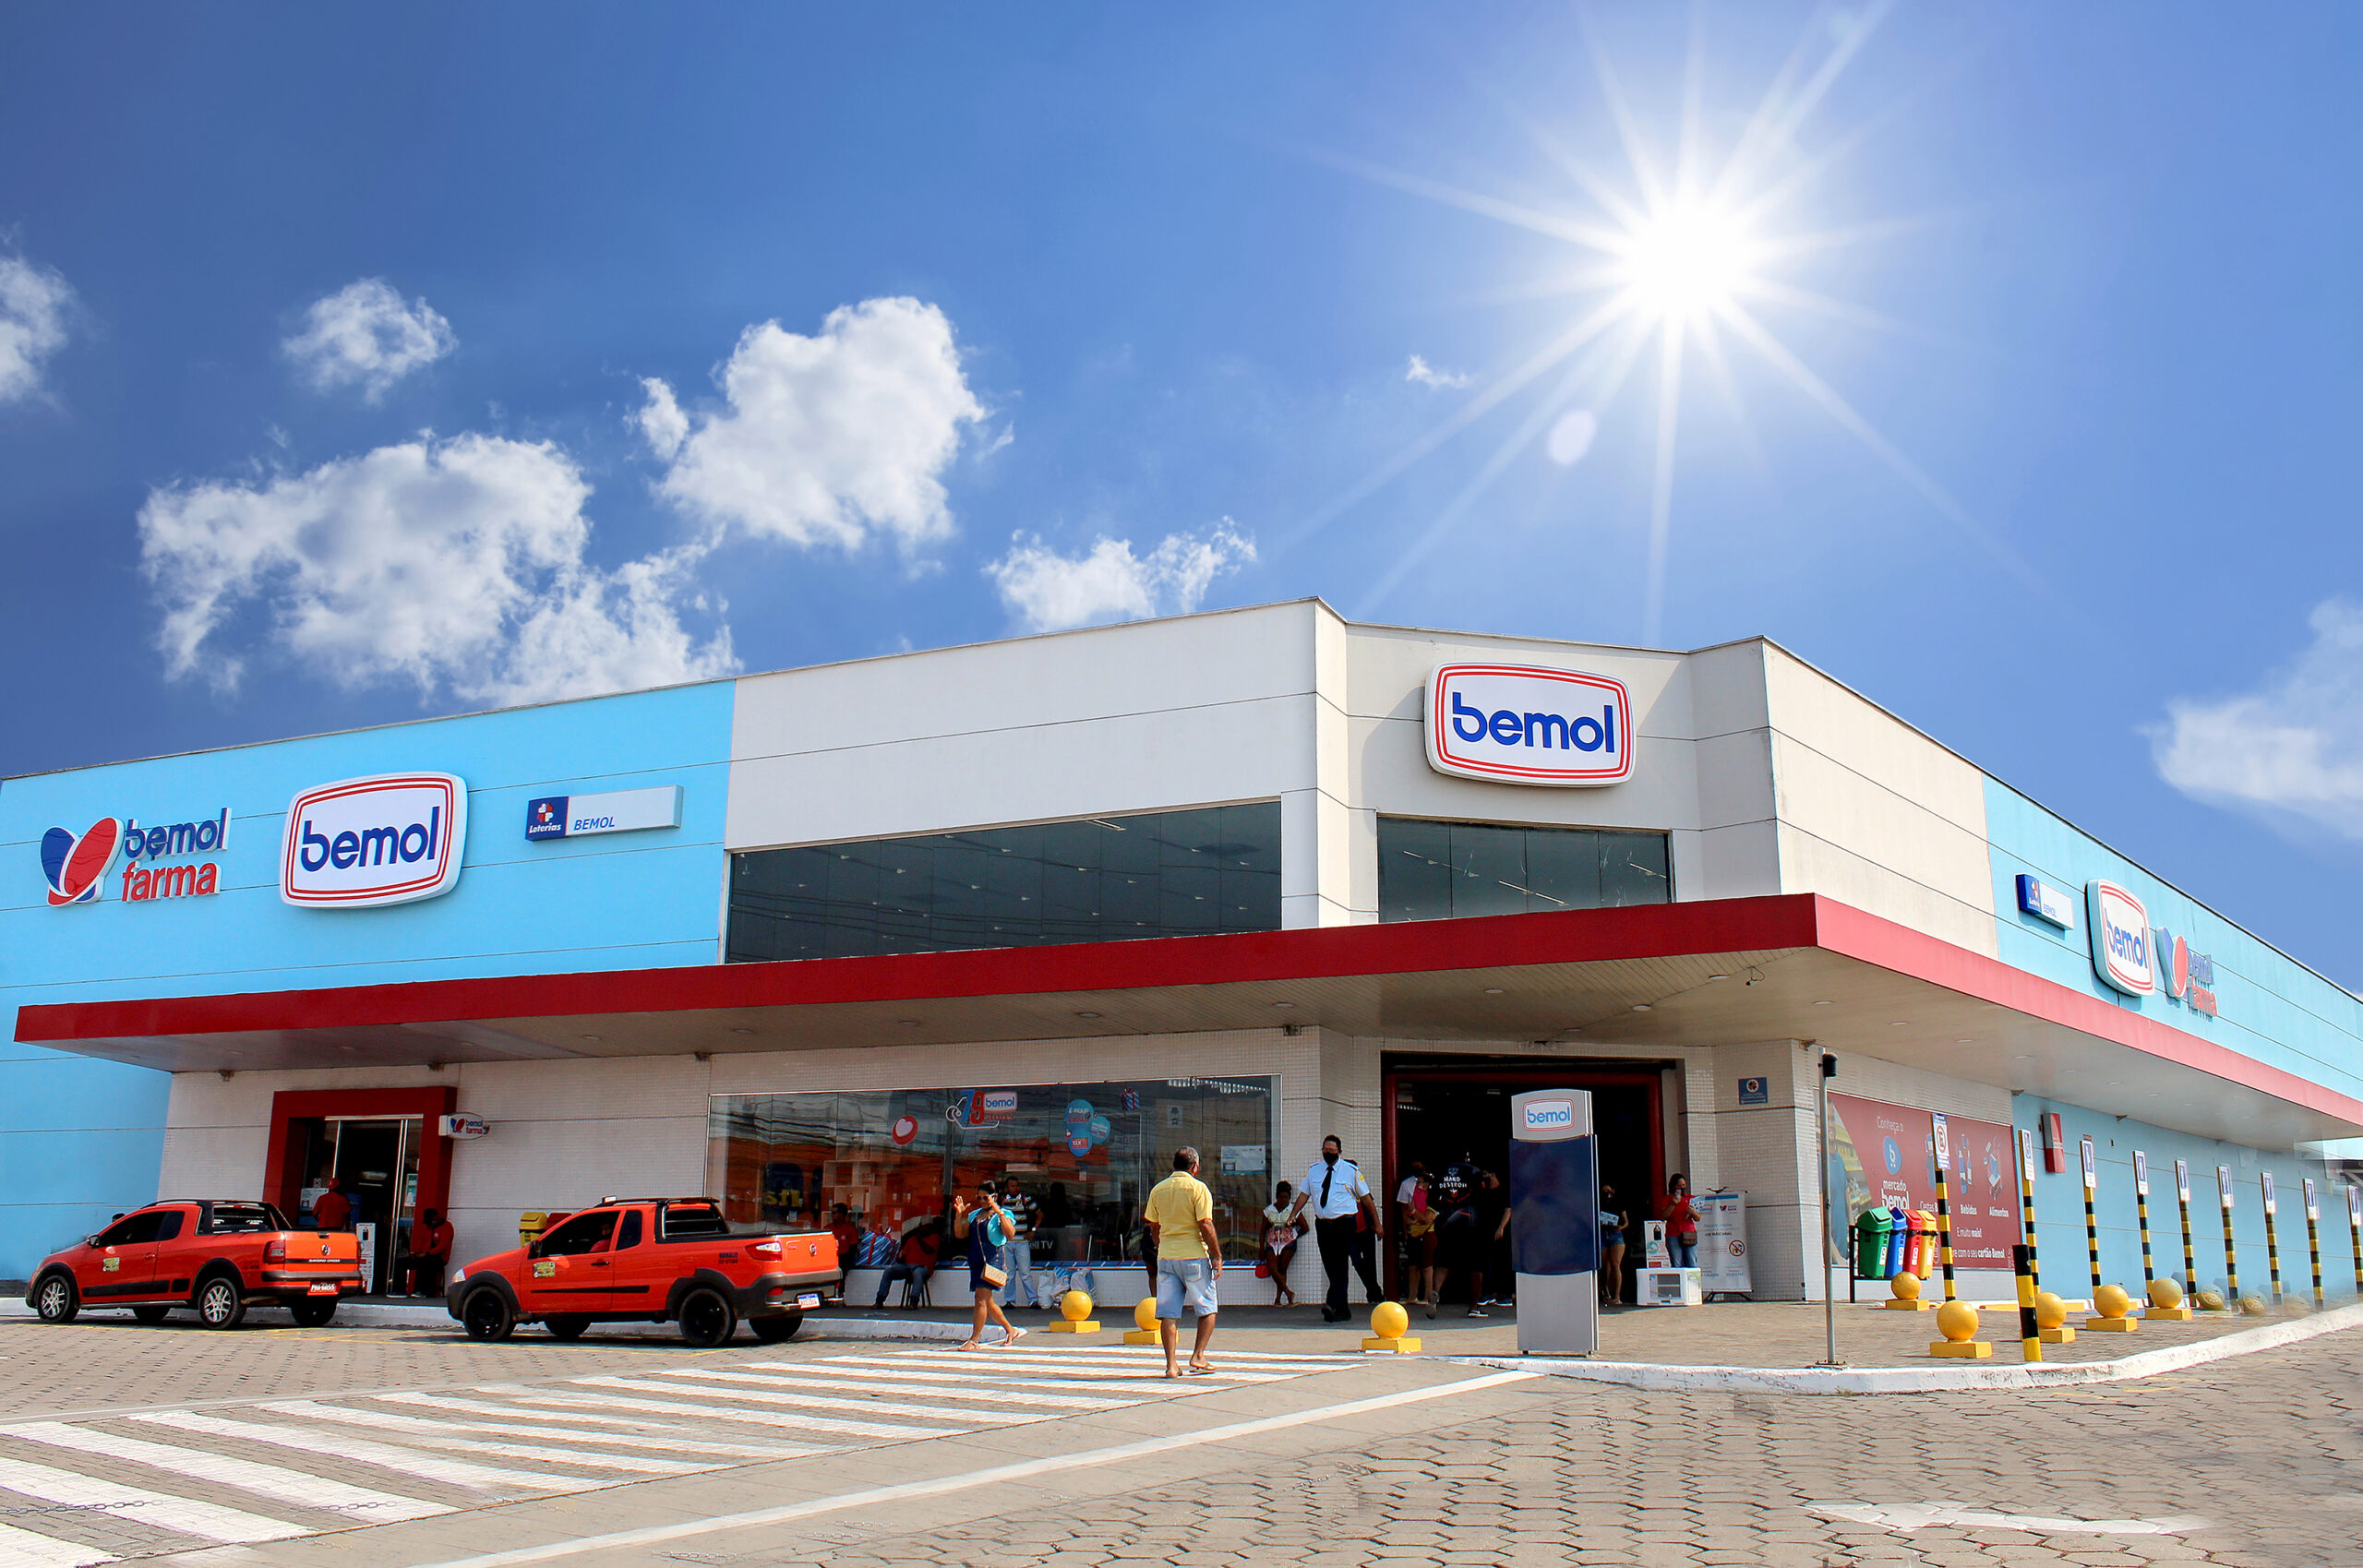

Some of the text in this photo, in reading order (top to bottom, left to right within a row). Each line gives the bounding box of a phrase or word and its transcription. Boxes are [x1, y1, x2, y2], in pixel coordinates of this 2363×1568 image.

[1452, 691, 1615, 753] bemol
[528, 822, 561, 834] Loterias
[573, 816, 616, 831] BEMOL
[124, 807, 230, 859] bemol
[300, 806, 440, 872] bemol
[121, 861, 220, 903] farma
[2105, 908, 2148, 969] bemol
[985, 1096, 1015, 1108] bemol
[1527, 1107, 1571, 1123] bemol
[1876, 1116, 1900, 1134] Conheça
[1883, 1179, 1907, 1192] mercado
[1880, 1188, 1910, 1211] bemol
[1960, 1203, 1978, 1215] Bebidas
[1989, 1205, 2009, 1218] Alimentos
